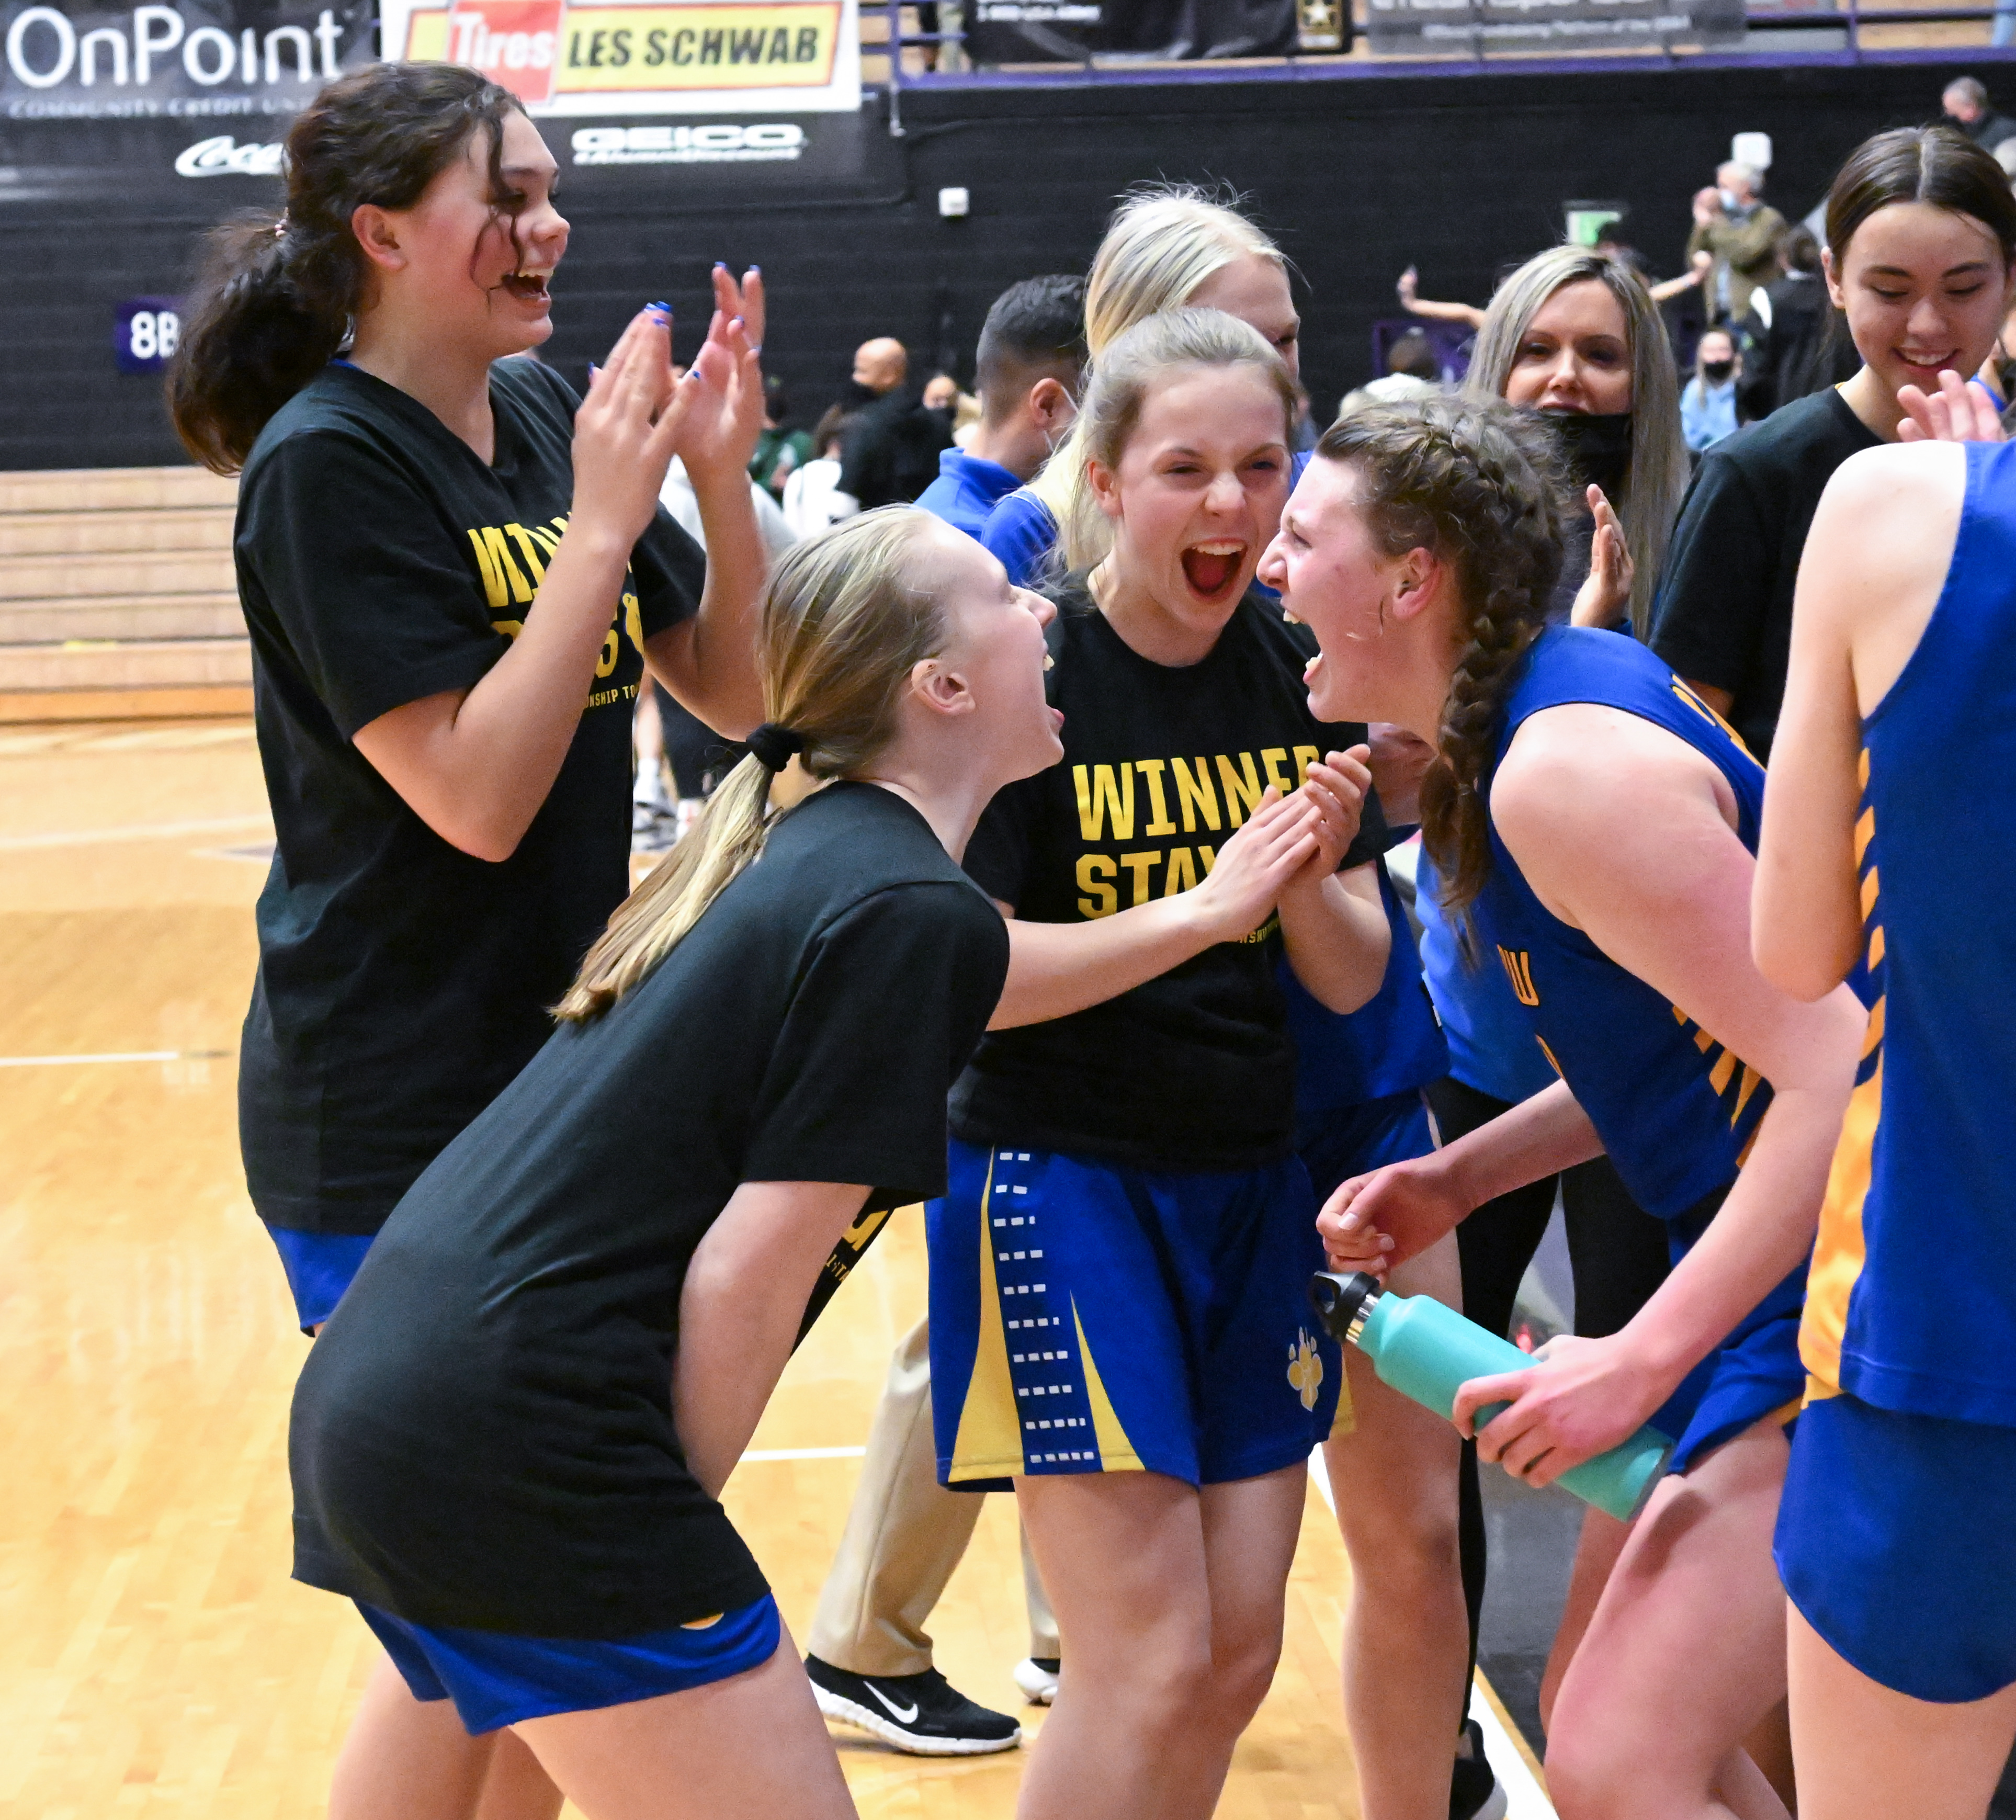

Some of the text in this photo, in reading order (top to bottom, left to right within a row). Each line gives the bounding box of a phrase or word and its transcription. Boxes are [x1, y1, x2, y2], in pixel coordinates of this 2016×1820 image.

[7, 5, 345, 88] OnPoint
[453, 12, 554, 69] Tires
[568, 26, 819, 69] LES SCHWAB
[572, 124, 804, 152] GEICO
[586, 688, 618, 708] NSHIP
[1075, 845, 1216, 920] STA
